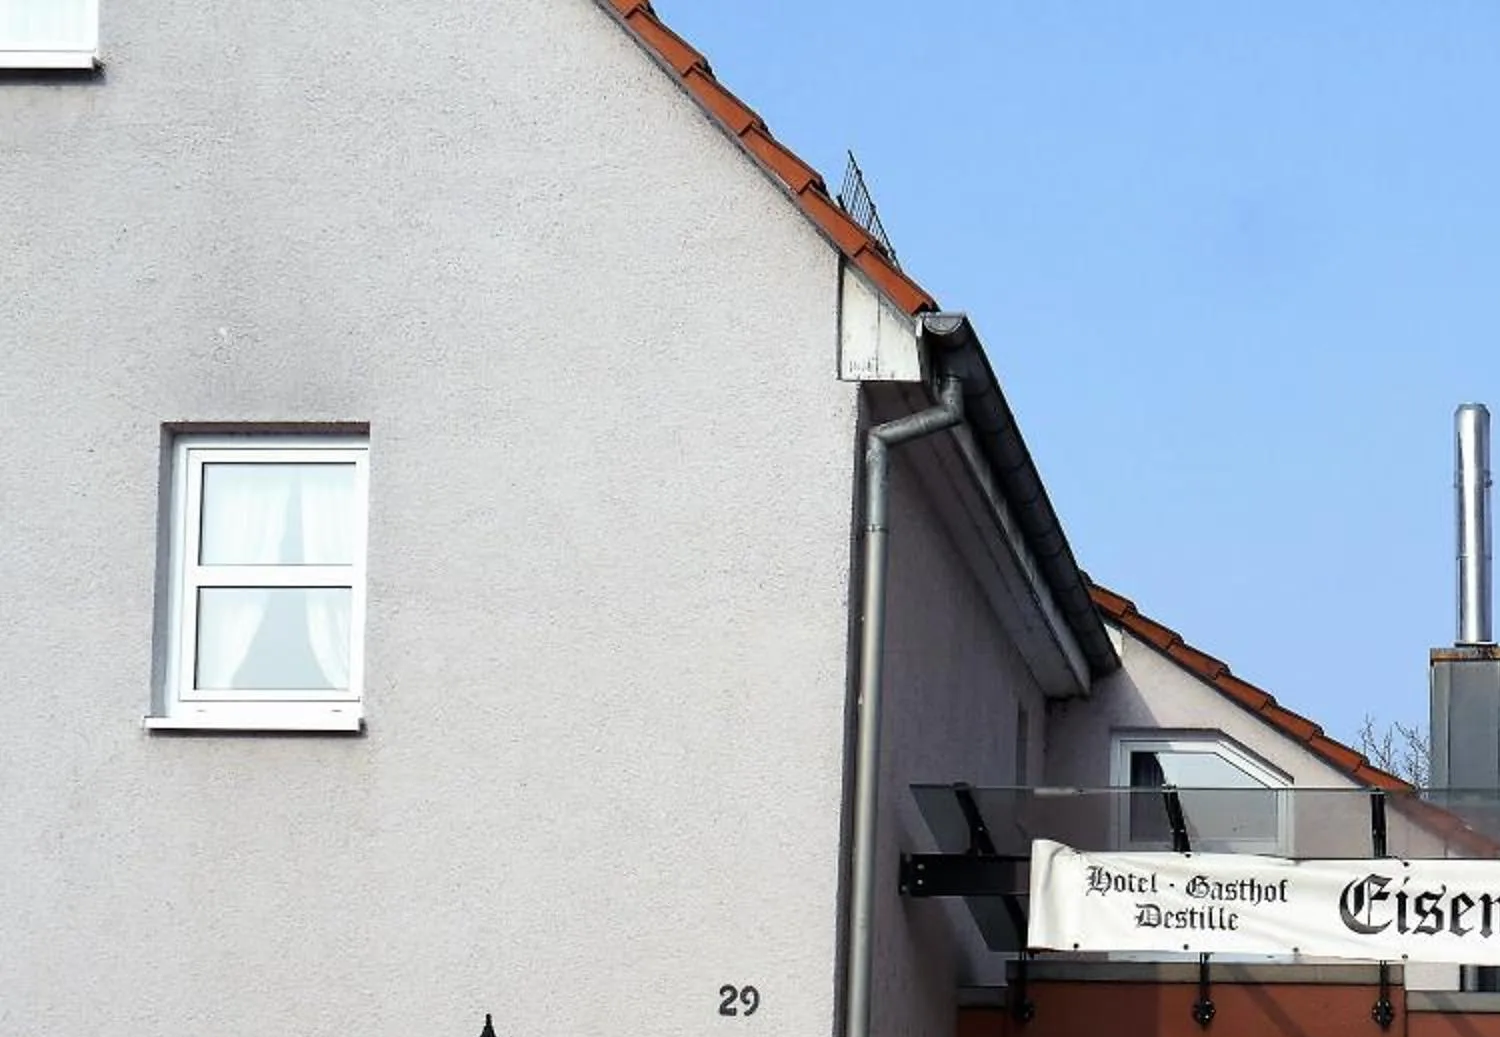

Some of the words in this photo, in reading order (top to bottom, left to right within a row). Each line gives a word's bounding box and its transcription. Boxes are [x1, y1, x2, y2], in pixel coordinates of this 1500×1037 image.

[1085, 865, 1158, 896] Hotel
[1185, 874, 1289, 907] Gasthof
[1135, 903, 1239, 930] Destille
[718, 984, 760, 1017] 29
